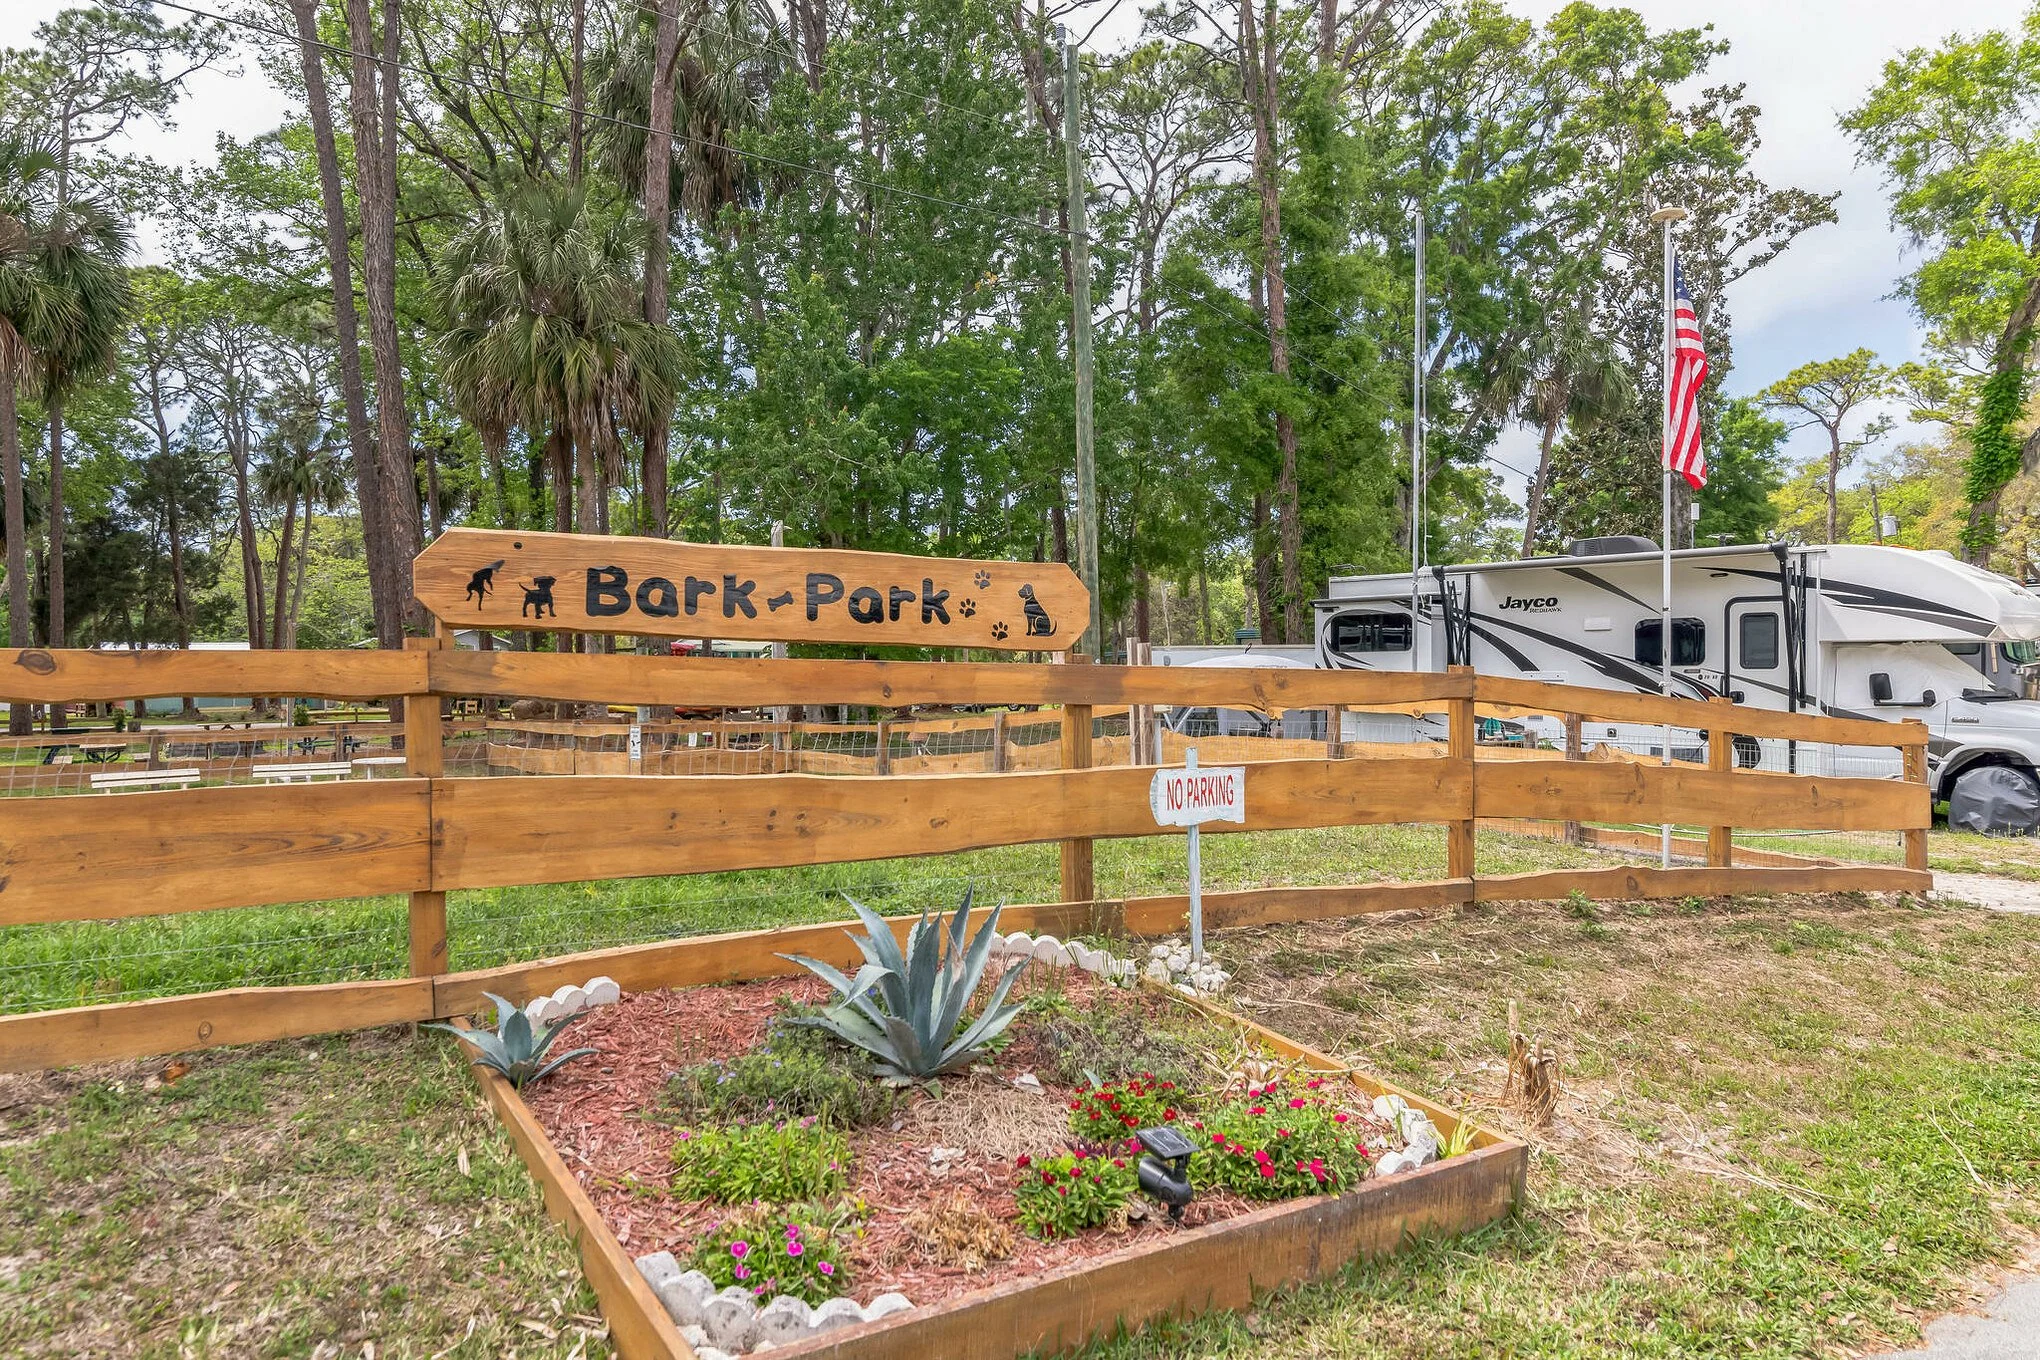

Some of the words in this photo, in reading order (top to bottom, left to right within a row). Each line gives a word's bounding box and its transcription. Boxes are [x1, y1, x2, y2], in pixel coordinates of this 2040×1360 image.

[586, 565, 758, 619] Bark
[806, 572, 951, 625] Park
[1499, 596, 1559, 611] Jayco
[1166, 778, 1183, 810] NO
[1187, 774, 1234, 809] PARKING
